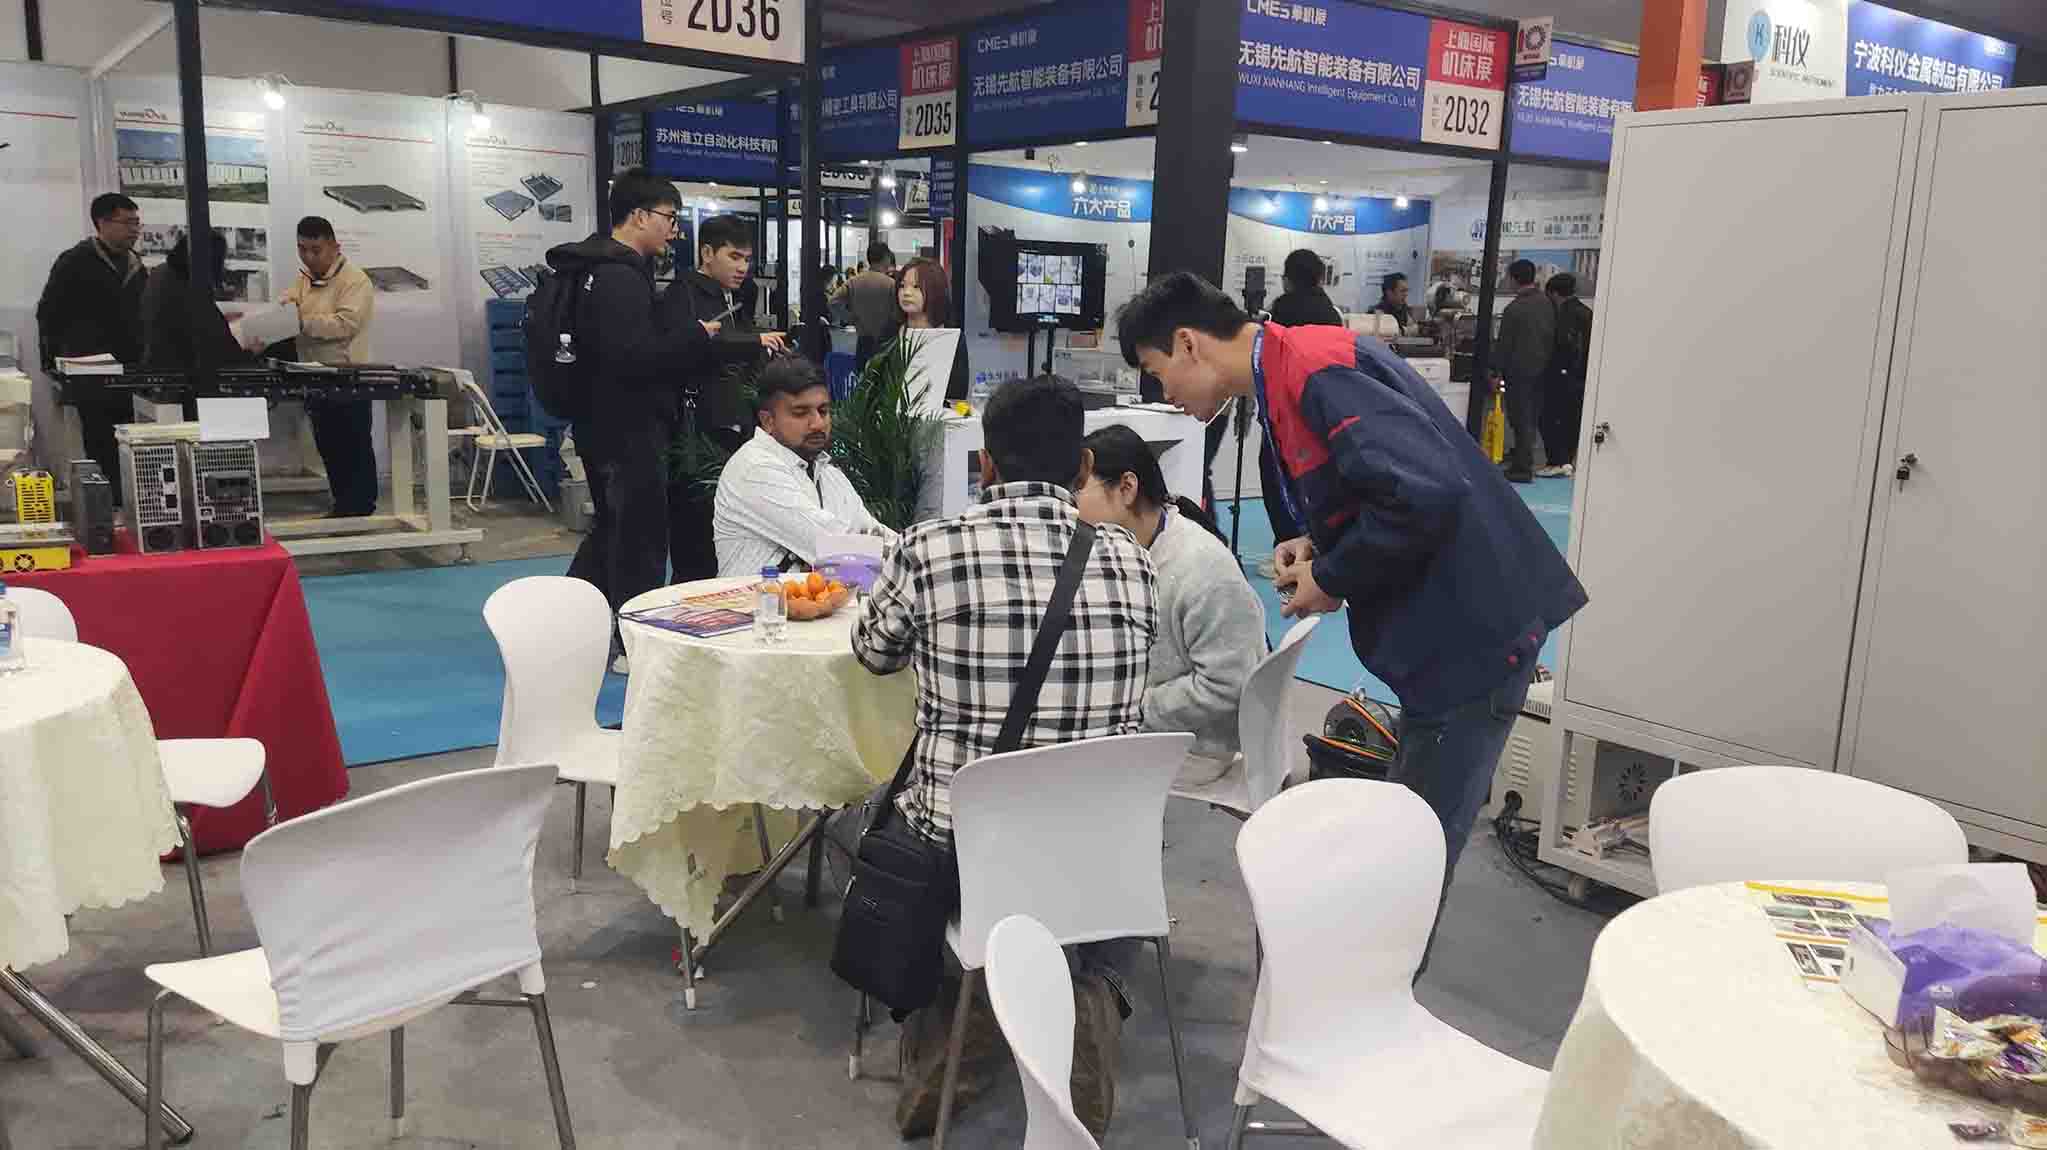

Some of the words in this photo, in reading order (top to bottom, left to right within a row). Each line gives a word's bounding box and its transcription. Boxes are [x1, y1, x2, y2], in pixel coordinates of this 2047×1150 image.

[688, 0, 780, 41] 2D36
[1238, 40, 1421, 91] 无锡先航智能装备有限公司
[1441, 50, 1494, 82] 机床展
[1772, 25, 1810, 70] 科仪
[973, 54, 1123, 97] 无锡先航智能装备有限公司
[915, 102, 952, 137] 2D35
[1443, 95, 1490, 136] 2D32
[1073, 196, 1131, 218] 六大产品
[1311, 214, 1355, 231] 六大产品
